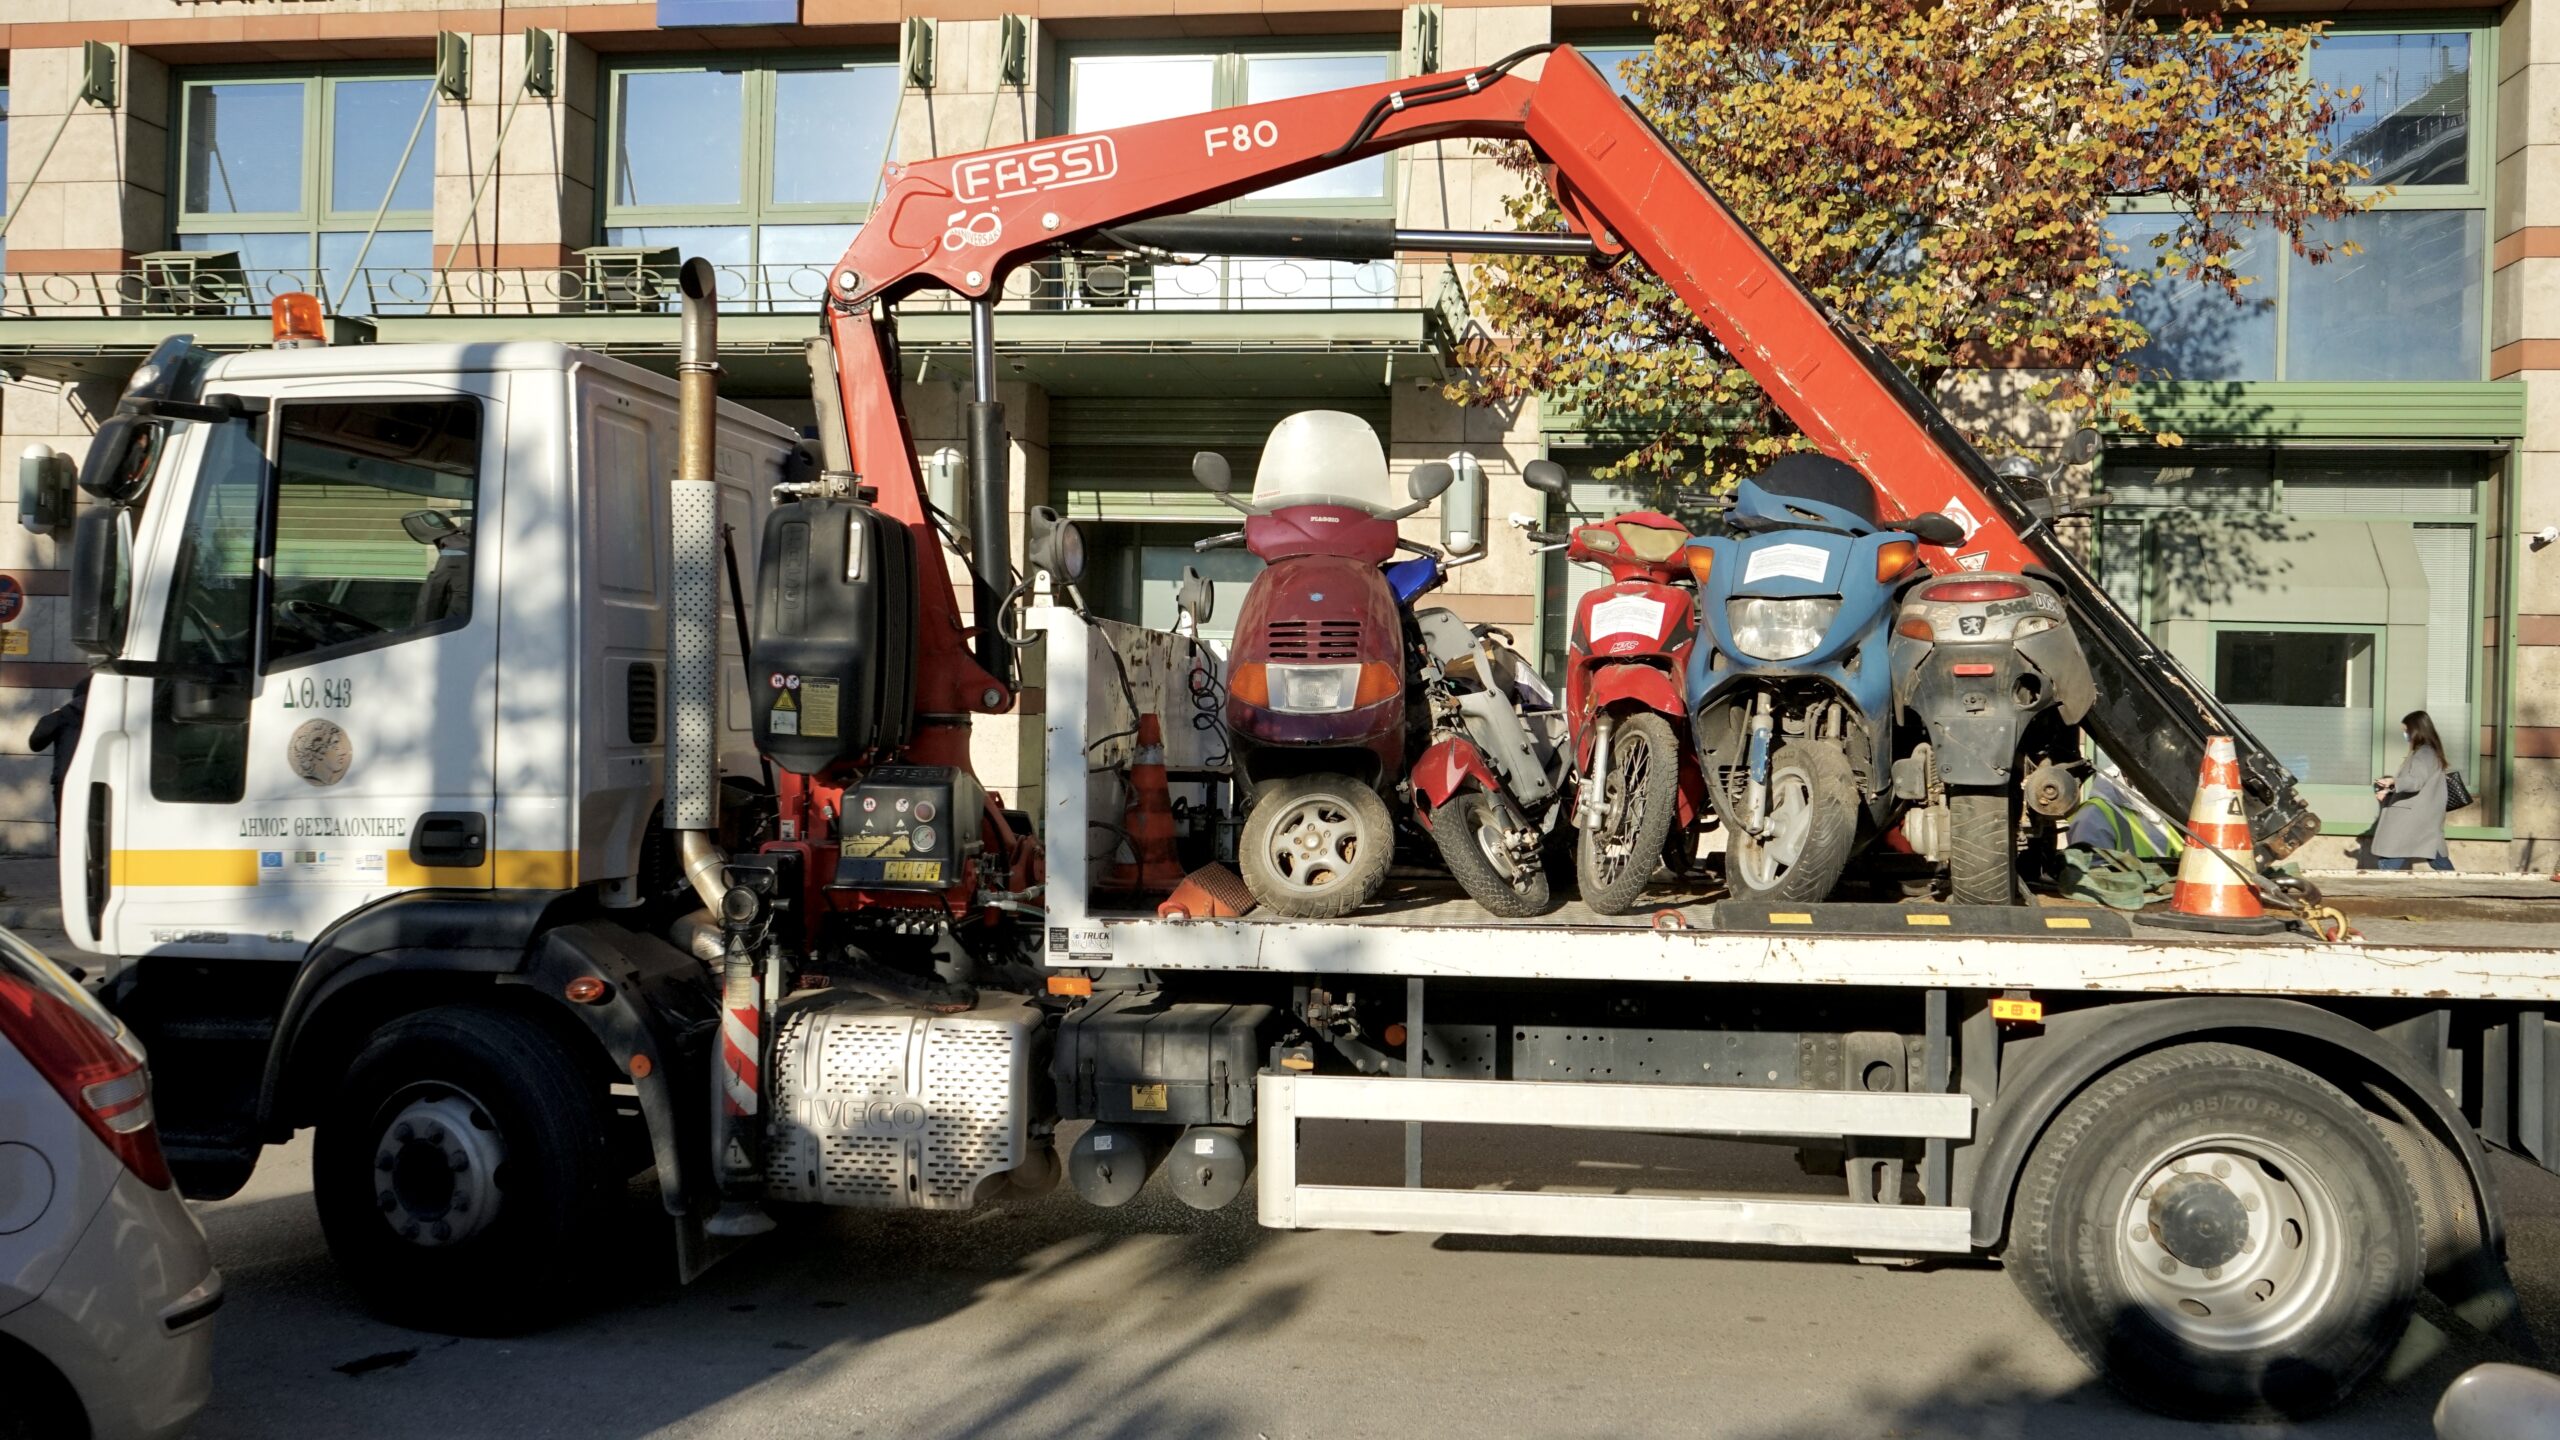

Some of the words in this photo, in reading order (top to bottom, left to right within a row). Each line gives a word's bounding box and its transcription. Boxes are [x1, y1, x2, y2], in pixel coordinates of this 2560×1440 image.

[1204, 119, 1278, 157] F80
[964, 143, 1105, 196] FASSI
[323, 678, 352, 709] 843
[239, 817, 288, 837] ΔΗΜΟΣ
[293, 817, 406, 837] ΘΕΣΣΑΛΟΝΙΚΗΣ
[1082, 931, 1110, 940] TRUCK
[798, 1099, 926, 1131] IVECO
